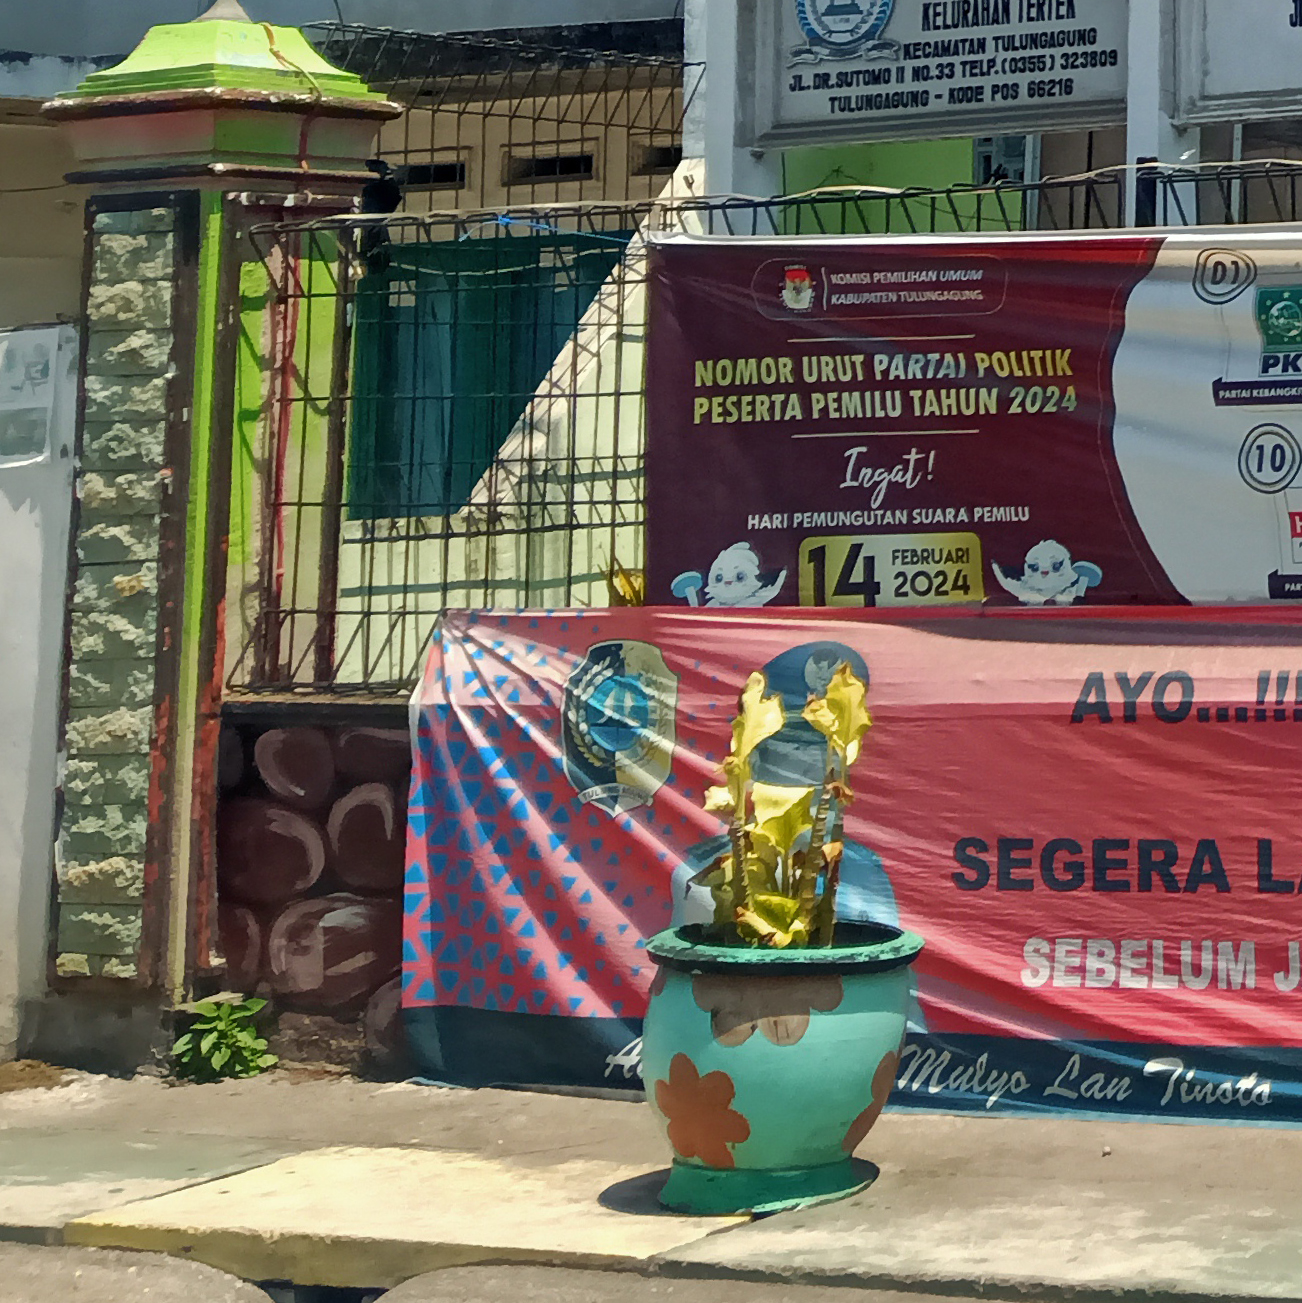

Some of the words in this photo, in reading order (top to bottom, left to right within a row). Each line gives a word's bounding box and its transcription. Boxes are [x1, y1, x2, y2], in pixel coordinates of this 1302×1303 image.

[903, 36, 986, 60] KECAMATAN
[992, 28, 1097, 55] TULUNGAGUNG
[1060, 50, 1118, 69] 323809
[829, 91, 929, 114] TULUNGAGUNG
[948, 85, 984, 103] KODE
[990, 84, 1019, 101] POS
[1027, 79, 1073, 97] 66216
[830, 273, 870, 285] KOMISI
[873, 271, 938, 283] PEMILIHAN
[940, 269, 983, 281] UMUM
[831, 292, 897, 305] KABUPATEN
[899, 289, 983, 303] TULUNGAGUNG
[694, 355, 794, 387] NOMOR
[802, 355, 866, 382] URUT
[873, 353, 966, 379] PARTAI
[977, 349, 1072, 378] POLITIK
[694, 396, 801, 424] PESERTA
[812, 391, 901, 420] PEMILU
[910, 388, 997, 417] TAHUN
[1007, 385, 1077, 414] 2024
[1255, 444, 1286, 473] 10
[840, 446, 935, 509] Ingat!
[747, 513, 788, 530] HARI
[792, 509, 907, 529] PEMUNGUTAN
[912, 507, 968, 525] SUARA
[974, 507, 1029, 522] PEMILU
[808, 542, 879, 606] 14
[892, 548, 970, 565] FEBRUARI
[893, 569, 970, 597] 2024
[951, 837, 1230, 891] SEGERA
[1021, 938, 1258, 991] SEBELUM
